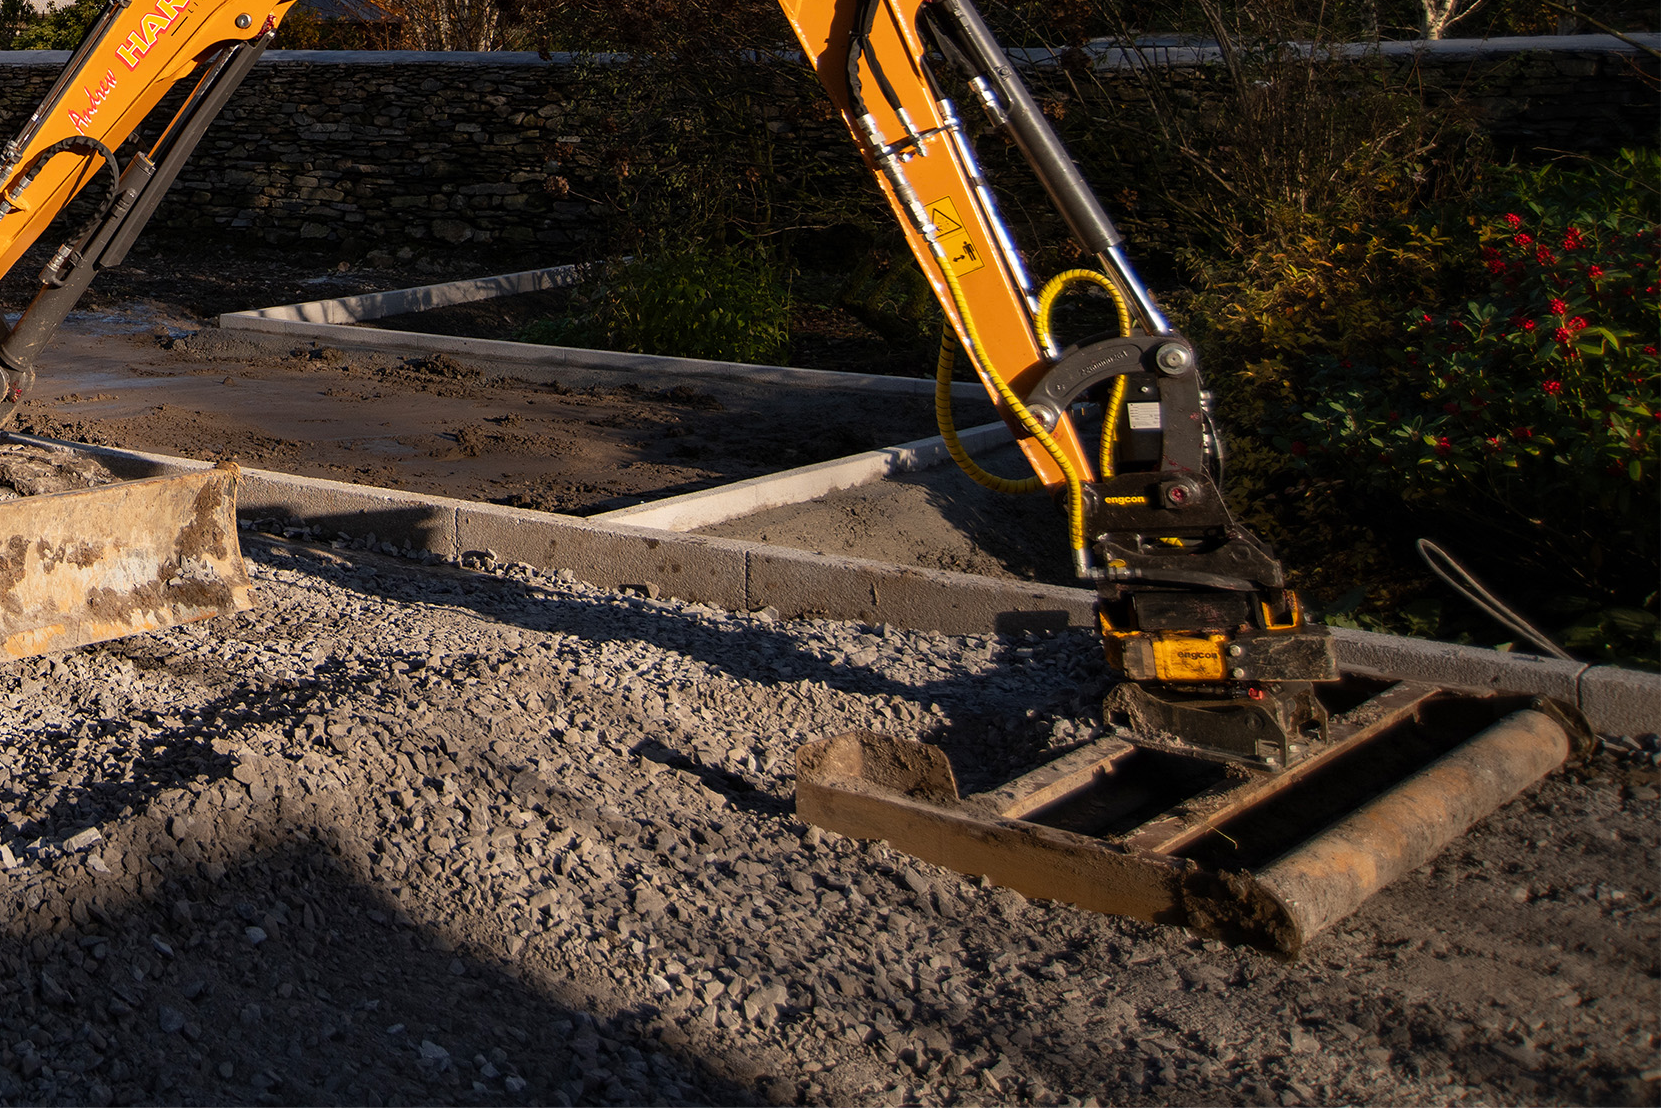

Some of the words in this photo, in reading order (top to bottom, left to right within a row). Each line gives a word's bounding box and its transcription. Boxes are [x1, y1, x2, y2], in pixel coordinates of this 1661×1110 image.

[67, 68, 117, 136] Andrew
[1104, 495, 1146, 506] engcon
[1177, 650, 1218, 660] engcon
